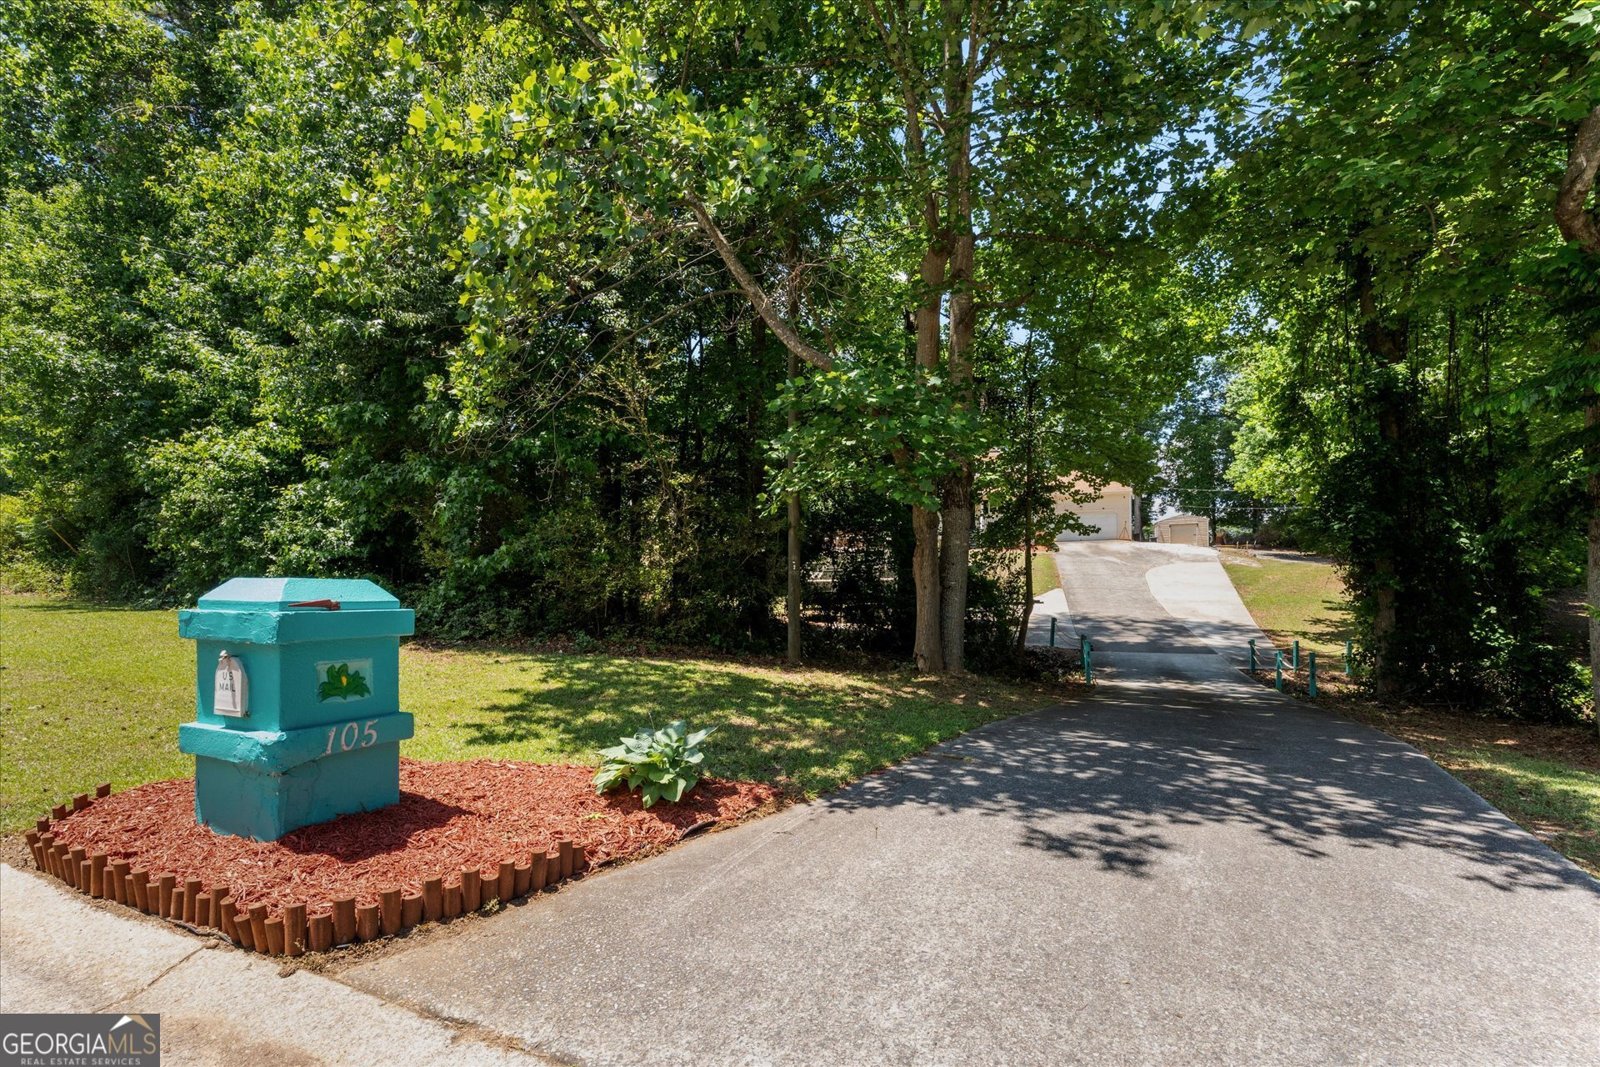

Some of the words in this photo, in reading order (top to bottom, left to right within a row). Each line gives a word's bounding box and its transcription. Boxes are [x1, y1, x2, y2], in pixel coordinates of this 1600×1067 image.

[222, 671, 234, 681] US
[219, 682, 236, 692] MAIL
[320, 719, 379, 758] 105
